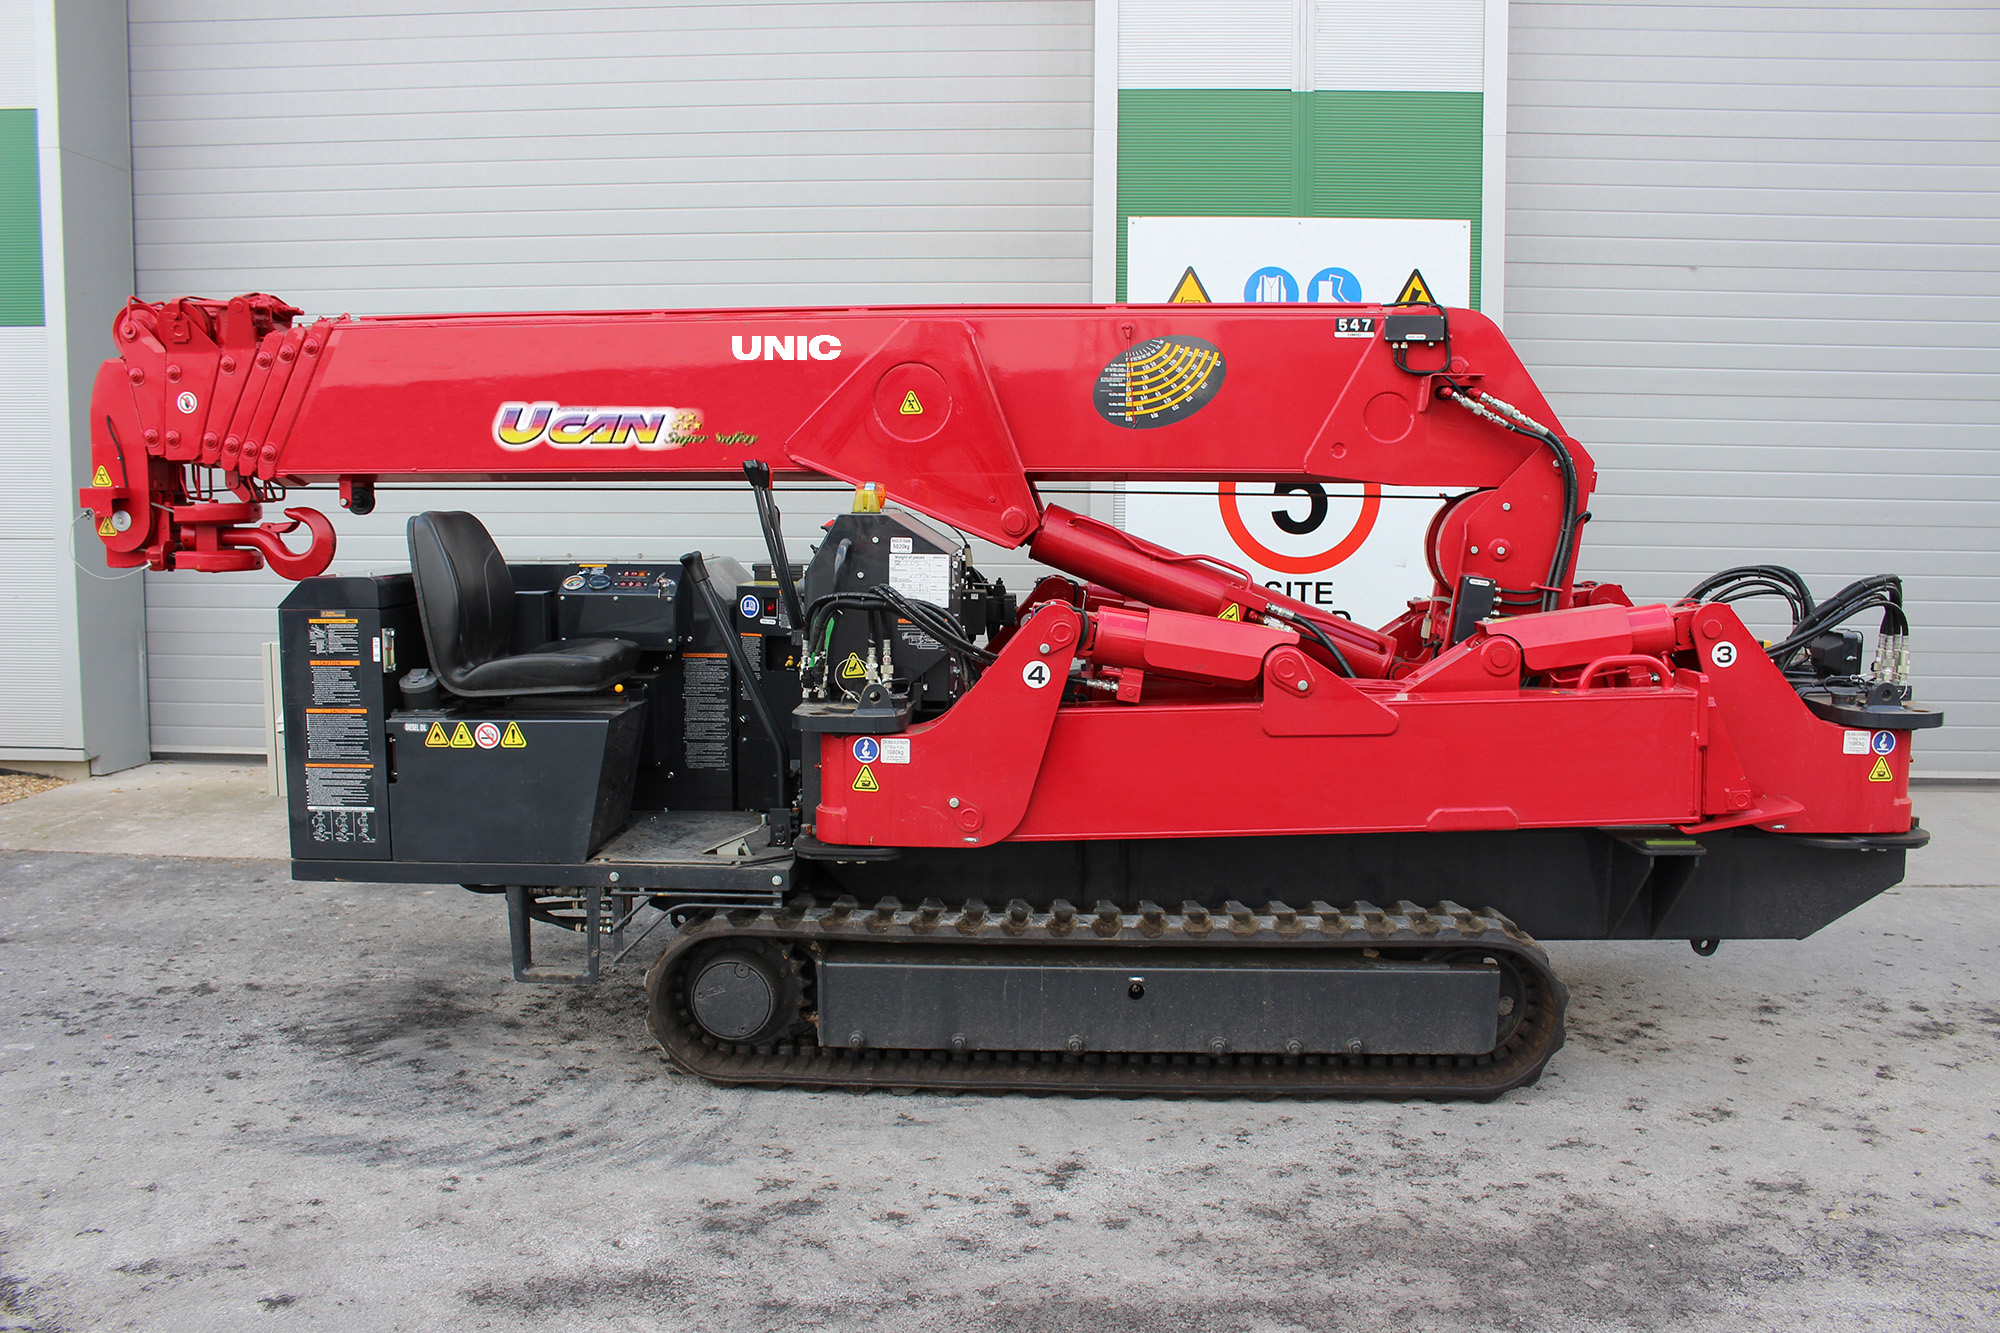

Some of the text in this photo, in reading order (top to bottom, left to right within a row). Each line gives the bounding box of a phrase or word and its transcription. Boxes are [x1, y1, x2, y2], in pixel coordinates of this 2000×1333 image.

[1338, 318, 1371, 332] 547
[731, 334, 842, 361] UNIC
[1272, 482, 1328, 535] 5
[1717, 645, 1732, 663] 3
[1027, 665, 1046, 685] 4
